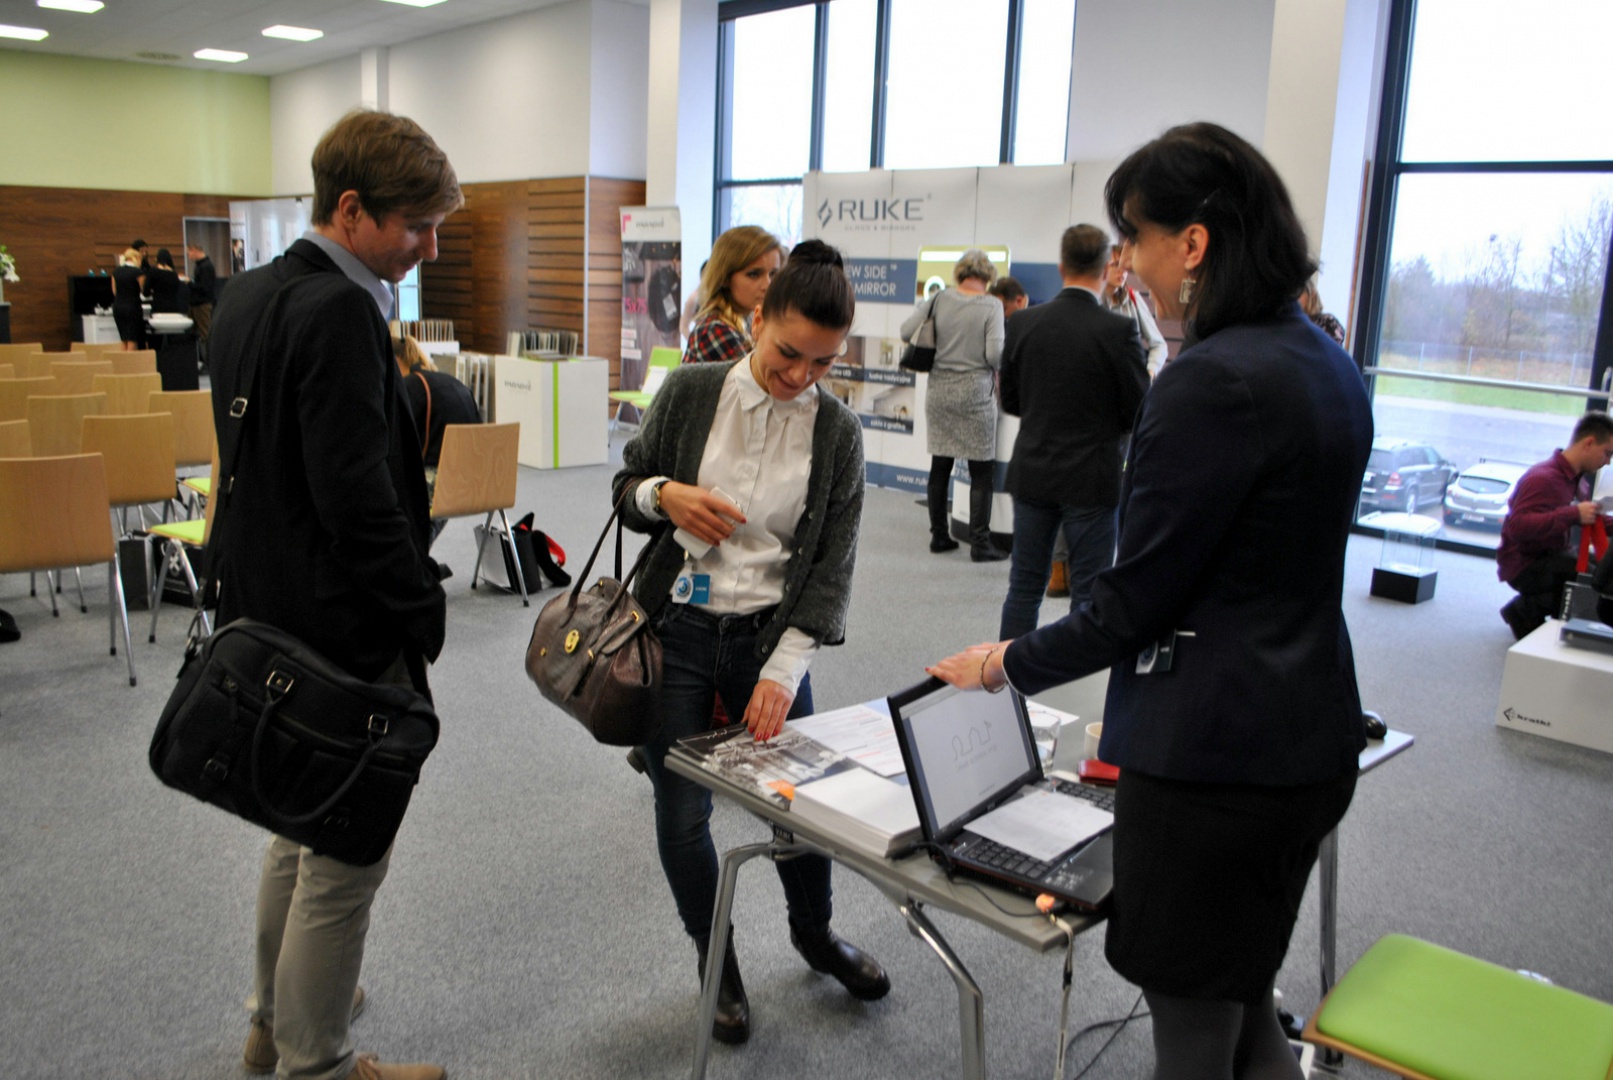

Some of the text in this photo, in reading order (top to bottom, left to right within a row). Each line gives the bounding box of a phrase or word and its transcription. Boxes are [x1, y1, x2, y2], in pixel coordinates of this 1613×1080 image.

[838, 198, 924, 221] RUKE
[842, 264, 862, 278] EW
[863, 264, 887, 280] SIDE
[854, 281, 897, 297] MIRROR
